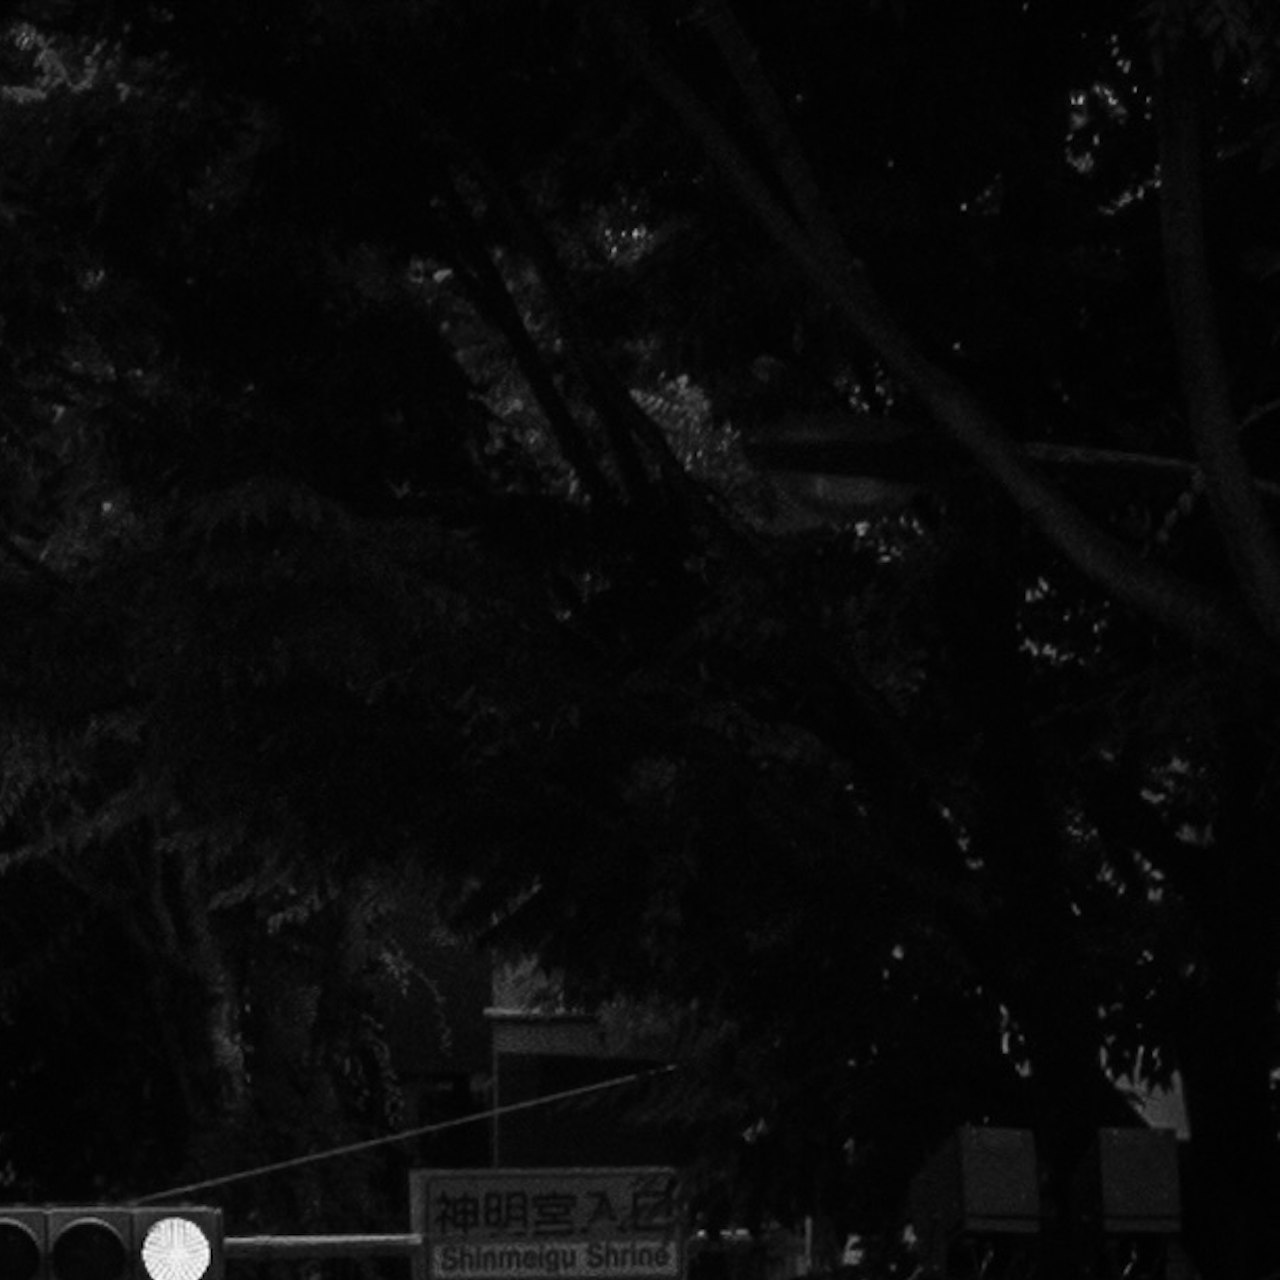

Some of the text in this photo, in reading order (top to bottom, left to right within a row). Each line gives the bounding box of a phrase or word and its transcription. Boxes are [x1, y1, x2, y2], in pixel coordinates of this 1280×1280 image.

[436, 1190, 672, 1235] 神明宮入口
[441, 1242, 670, 1273] Shinmeigu Shrine
